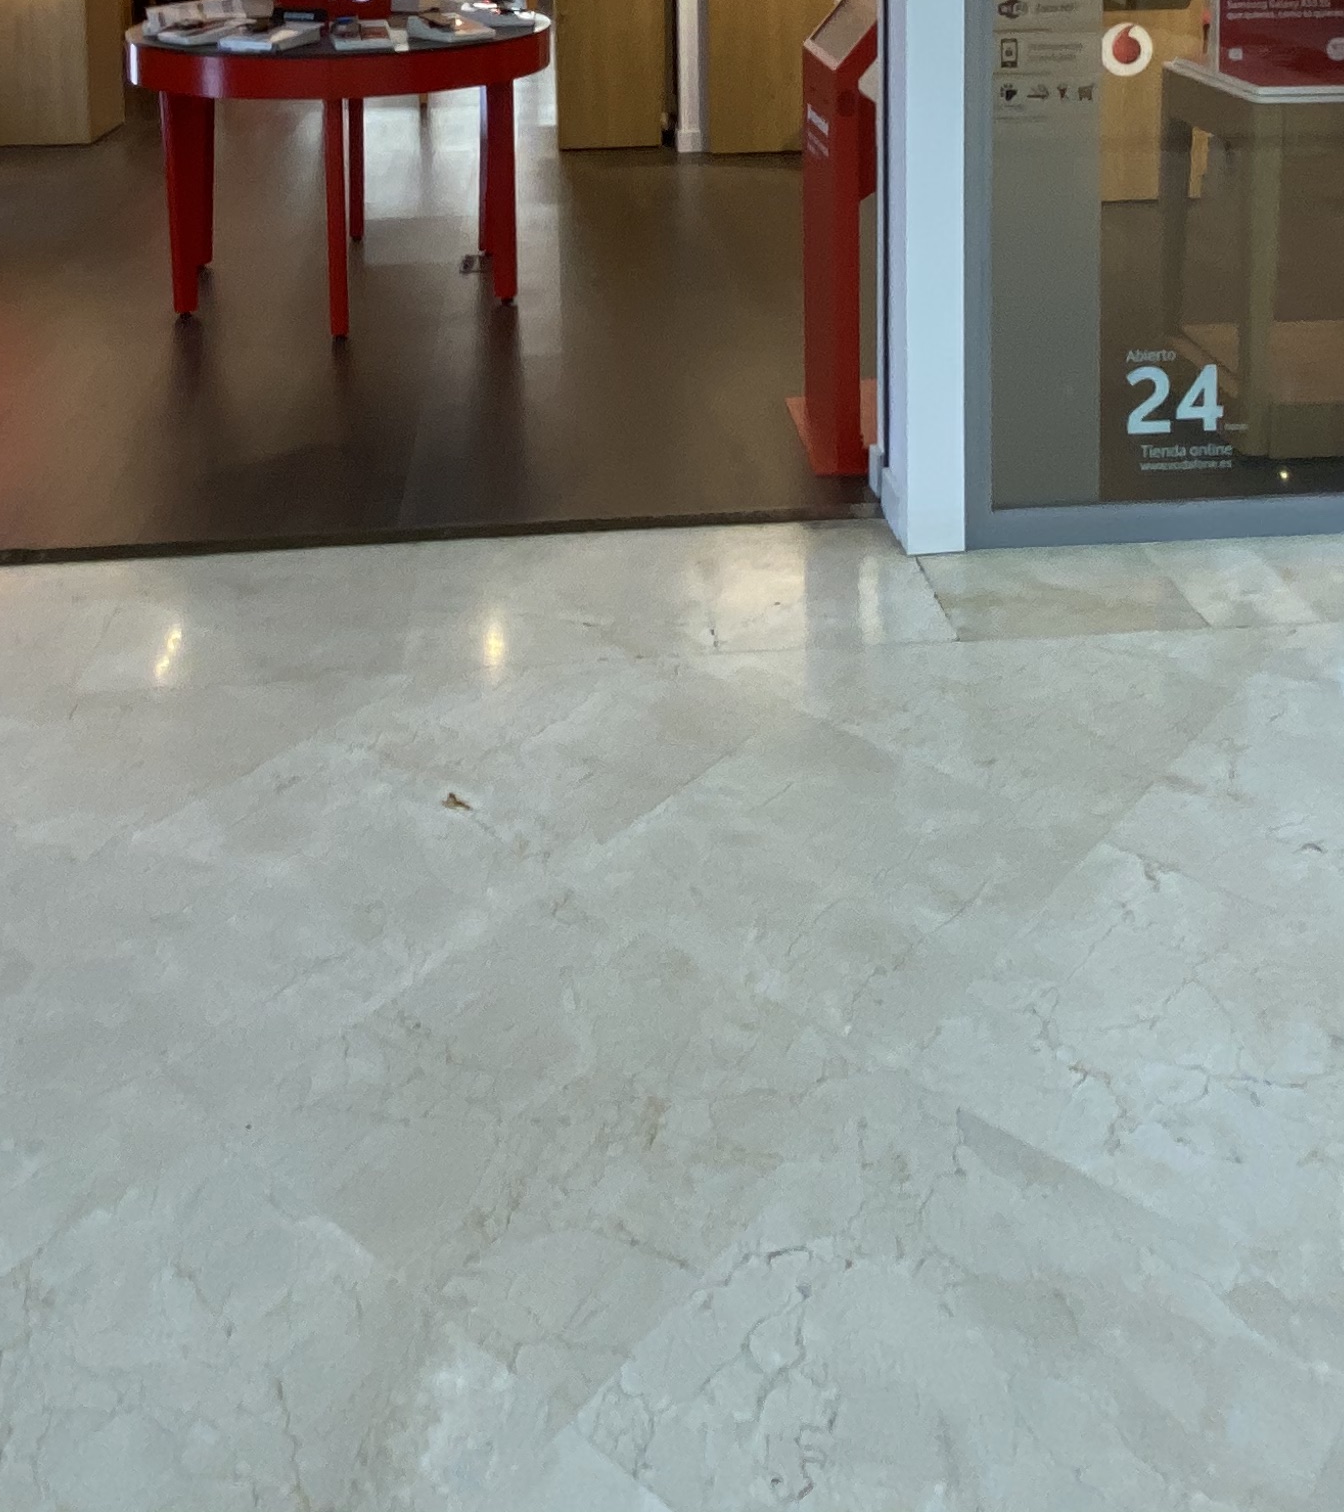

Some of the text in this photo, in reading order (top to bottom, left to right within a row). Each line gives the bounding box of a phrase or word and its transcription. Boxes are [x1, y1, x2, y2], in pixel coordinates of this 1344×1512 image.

[1126, 349, 1176, 363] Abierto
[1126, 363, 1225, 435] 24
[1141, 443, 1233, 458] Tienda online
